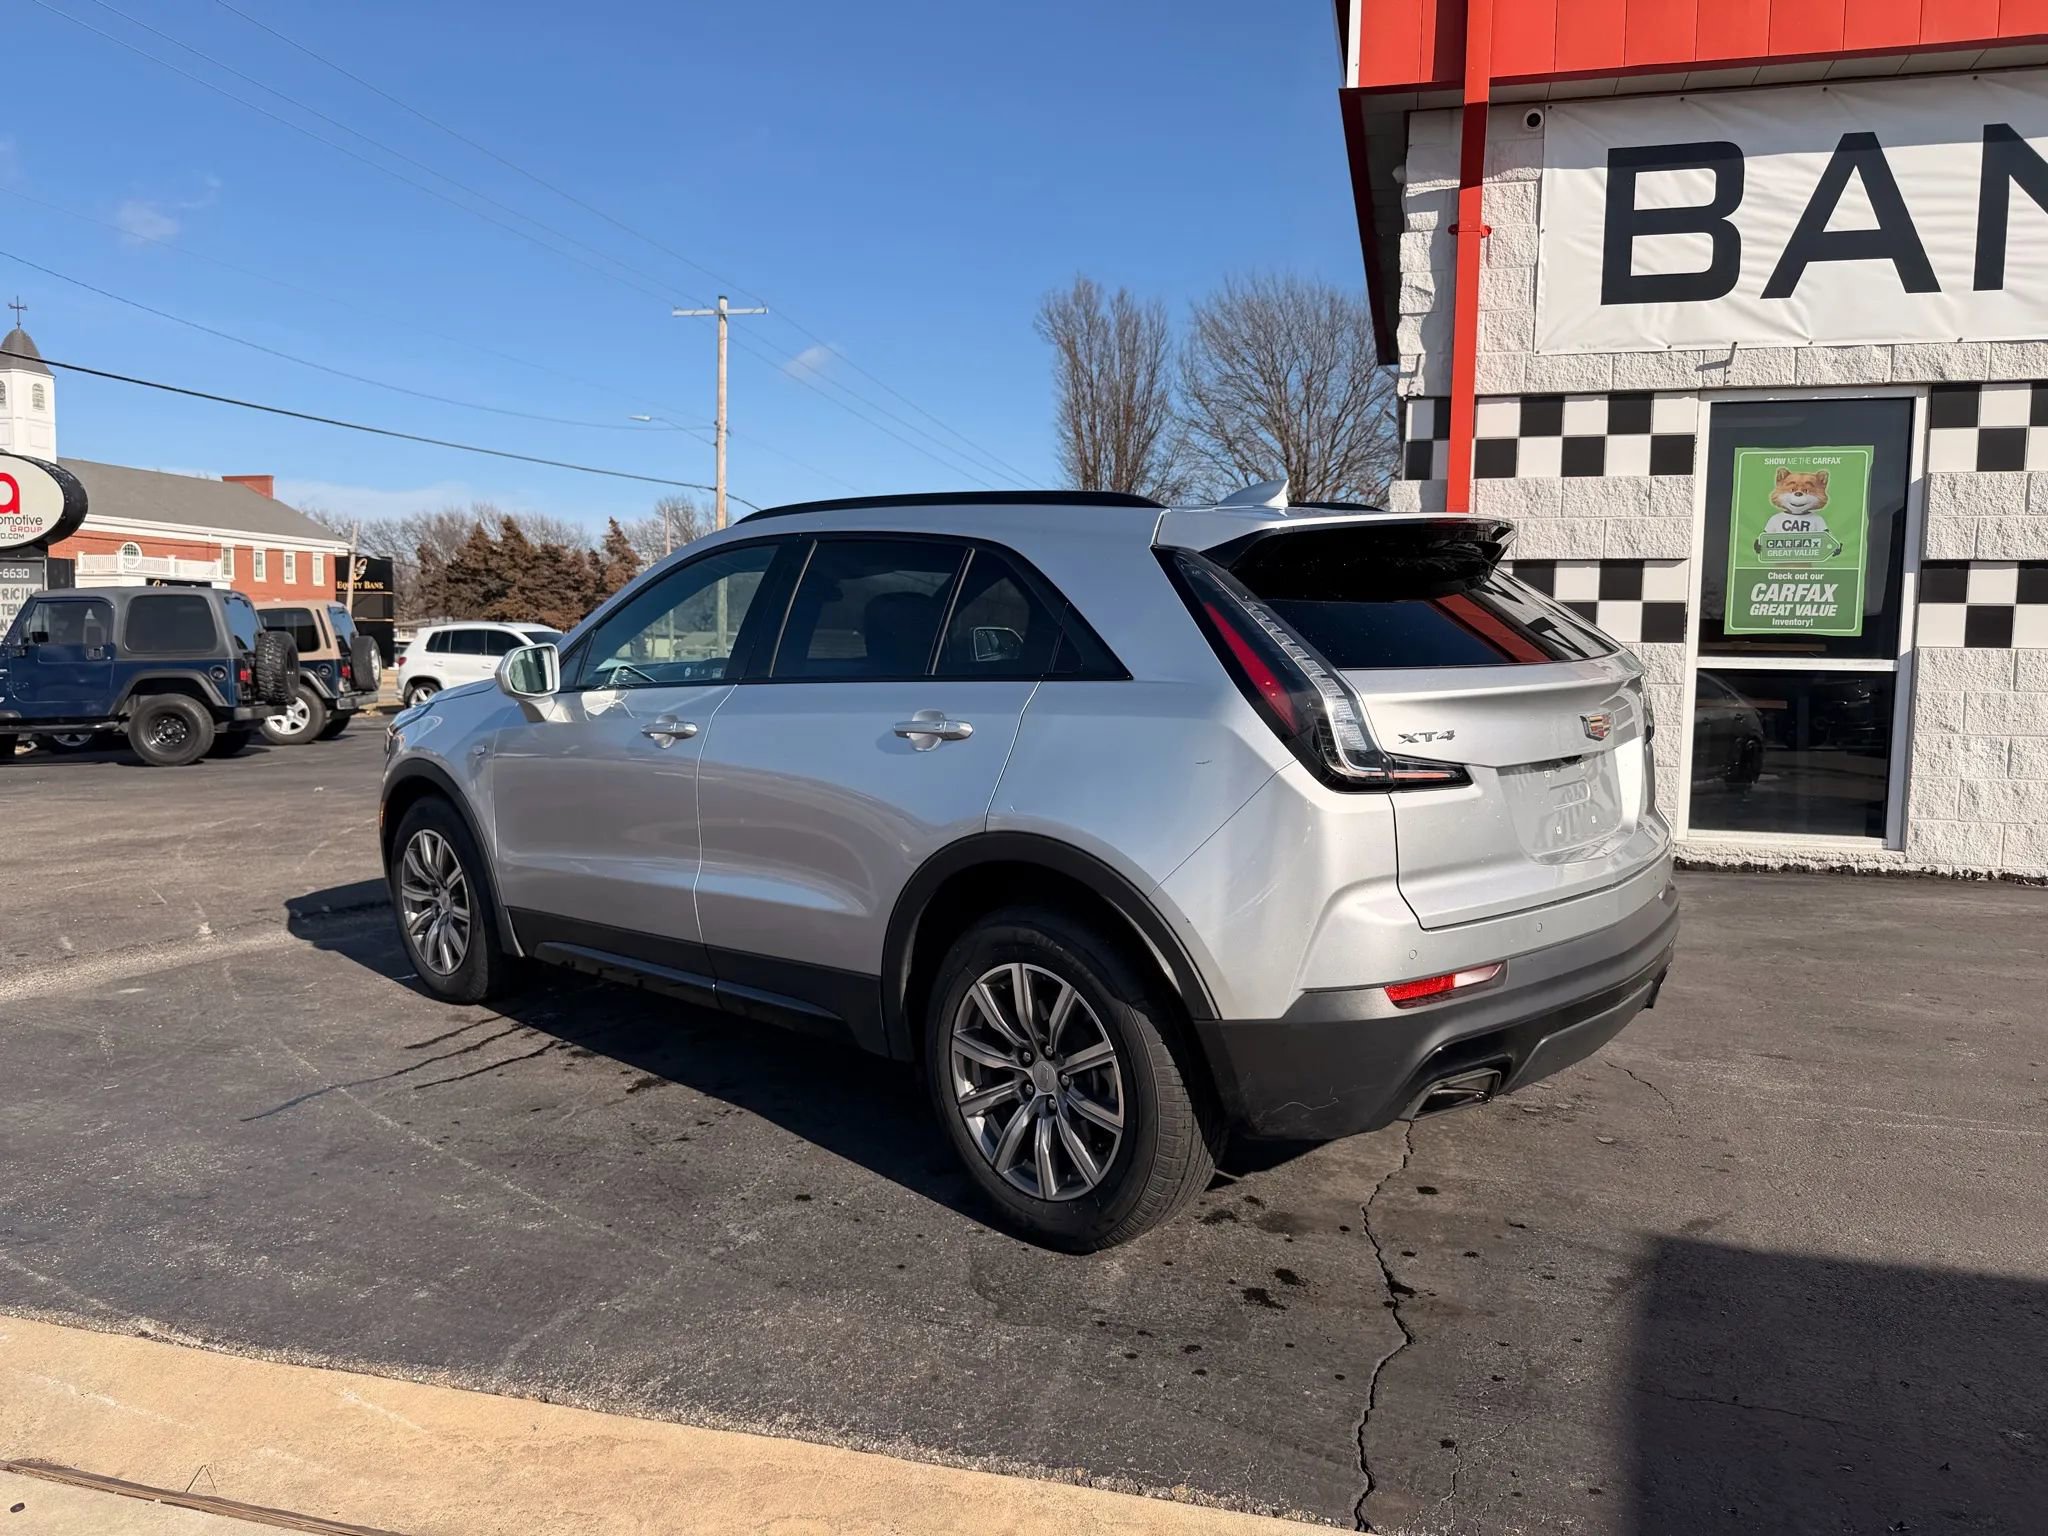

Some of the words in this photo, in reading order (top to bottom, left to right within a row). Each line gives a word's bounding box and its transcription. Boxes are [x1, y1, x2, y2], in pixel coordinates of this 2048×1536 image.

[1764, 457, 1786, 465] SHOW
[10, 525, 43, 533] GROUP
[1782, 520, 1811, 532] CAR
[1767, 539, 1821, 548] CARFAX
[1767, 549, 1793, 557] GREAT
[1794, 549, 1819, 557] VALUE
[1768, 572, 1792, 580] Check
[1750, 583, 1838, 602] CARFAX
[1750, 603, 1793, 616] GREAT
[1795, 604, 1838, 616] VALUE
[1772, 618, 1813, 627] Inventory!
[1398, 730, 1455, 744] XT4
